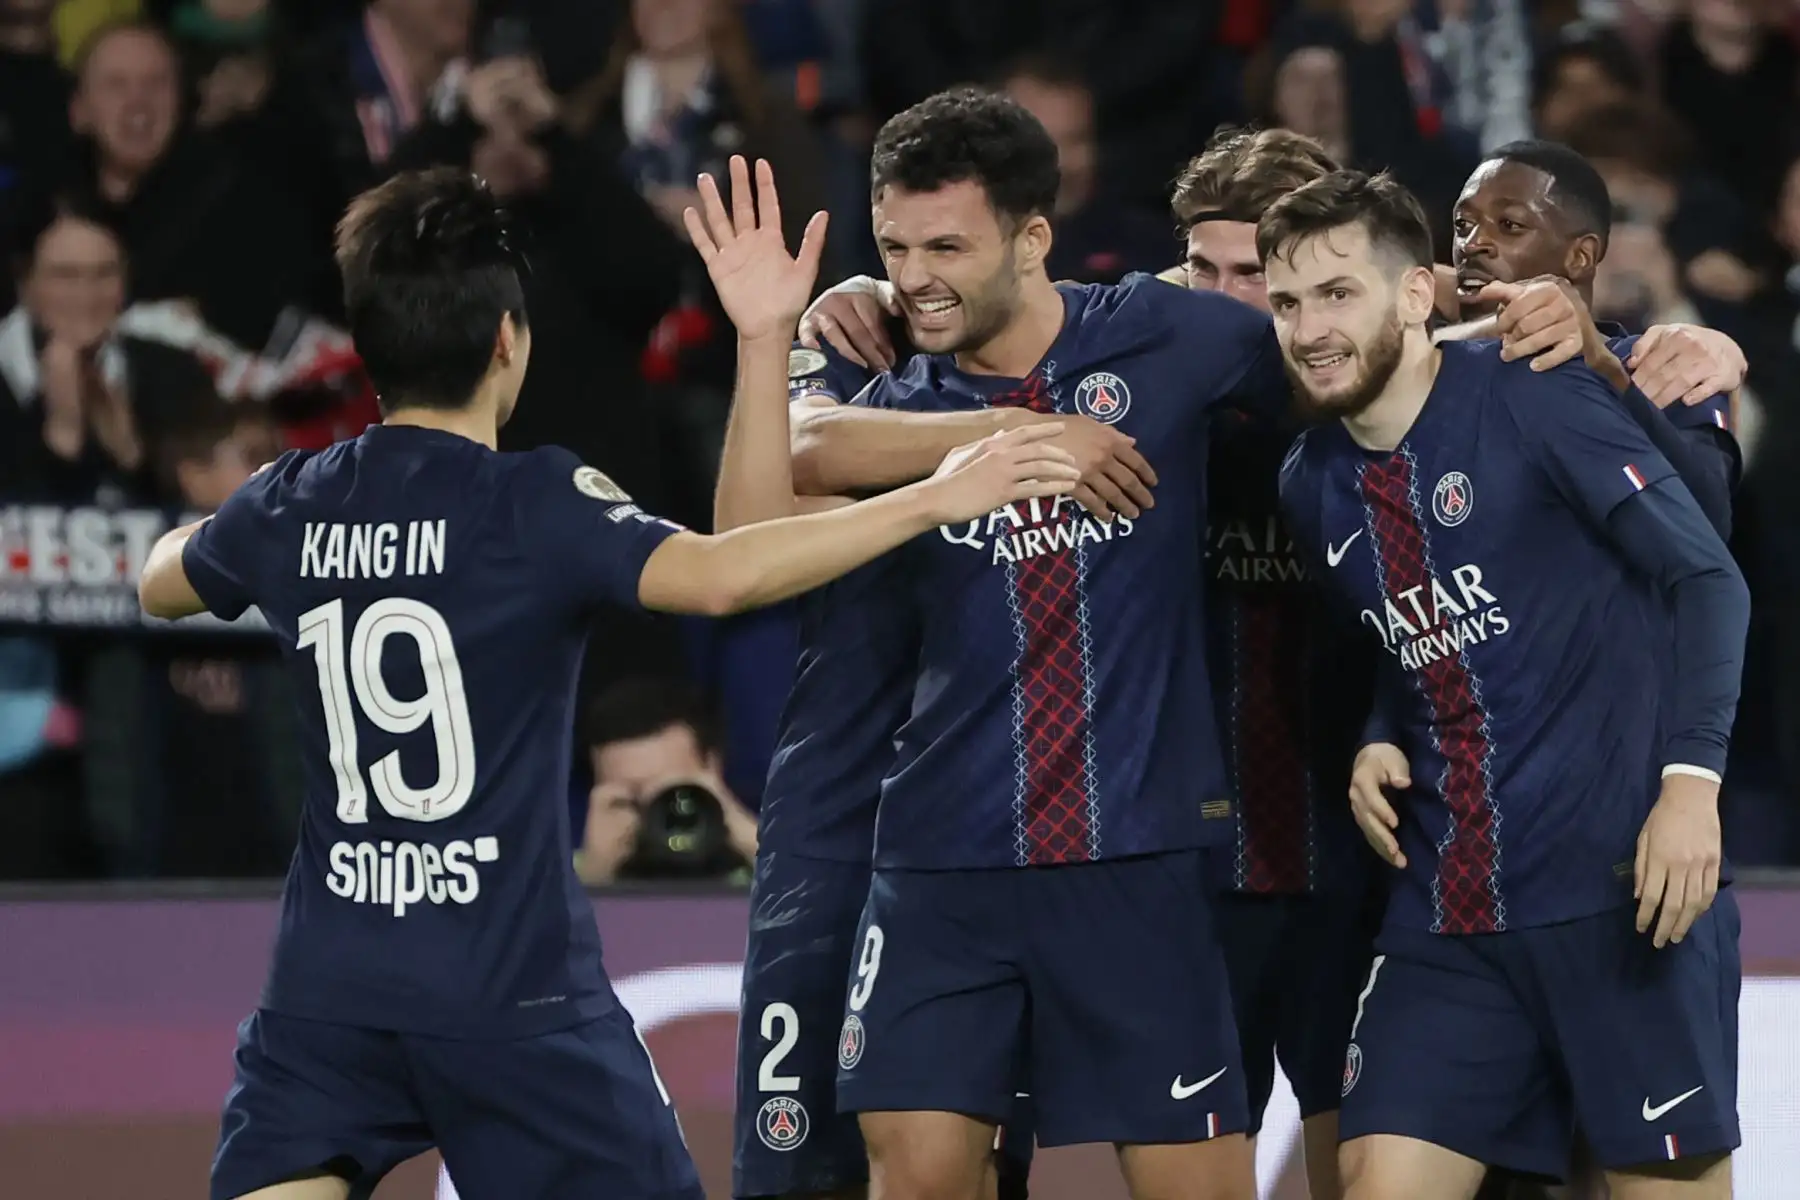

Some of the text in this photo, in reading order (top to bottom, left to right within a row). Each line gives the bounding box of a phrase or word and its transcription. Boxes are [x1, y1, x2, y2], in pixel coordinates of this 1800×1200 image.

[1081, 375, 1117, 391] PARIS
[1438, 475, 1464, 493] PARIS
[300, 519, 446, 579] KANG IN
[992, 513, 1134, 566] AIRWAYS
[1217, 556, 1310, 582] AIRW
[1401, 606, 1510, 672] AIRWAYS
[296, 597, 476, 824] 19
[326, 840, 480, 917] snipes
[850, 925, 884, 1011] 9
[758, 1002, 800, 1092] 2
[765, 1099, 799, 1113] PARIS
